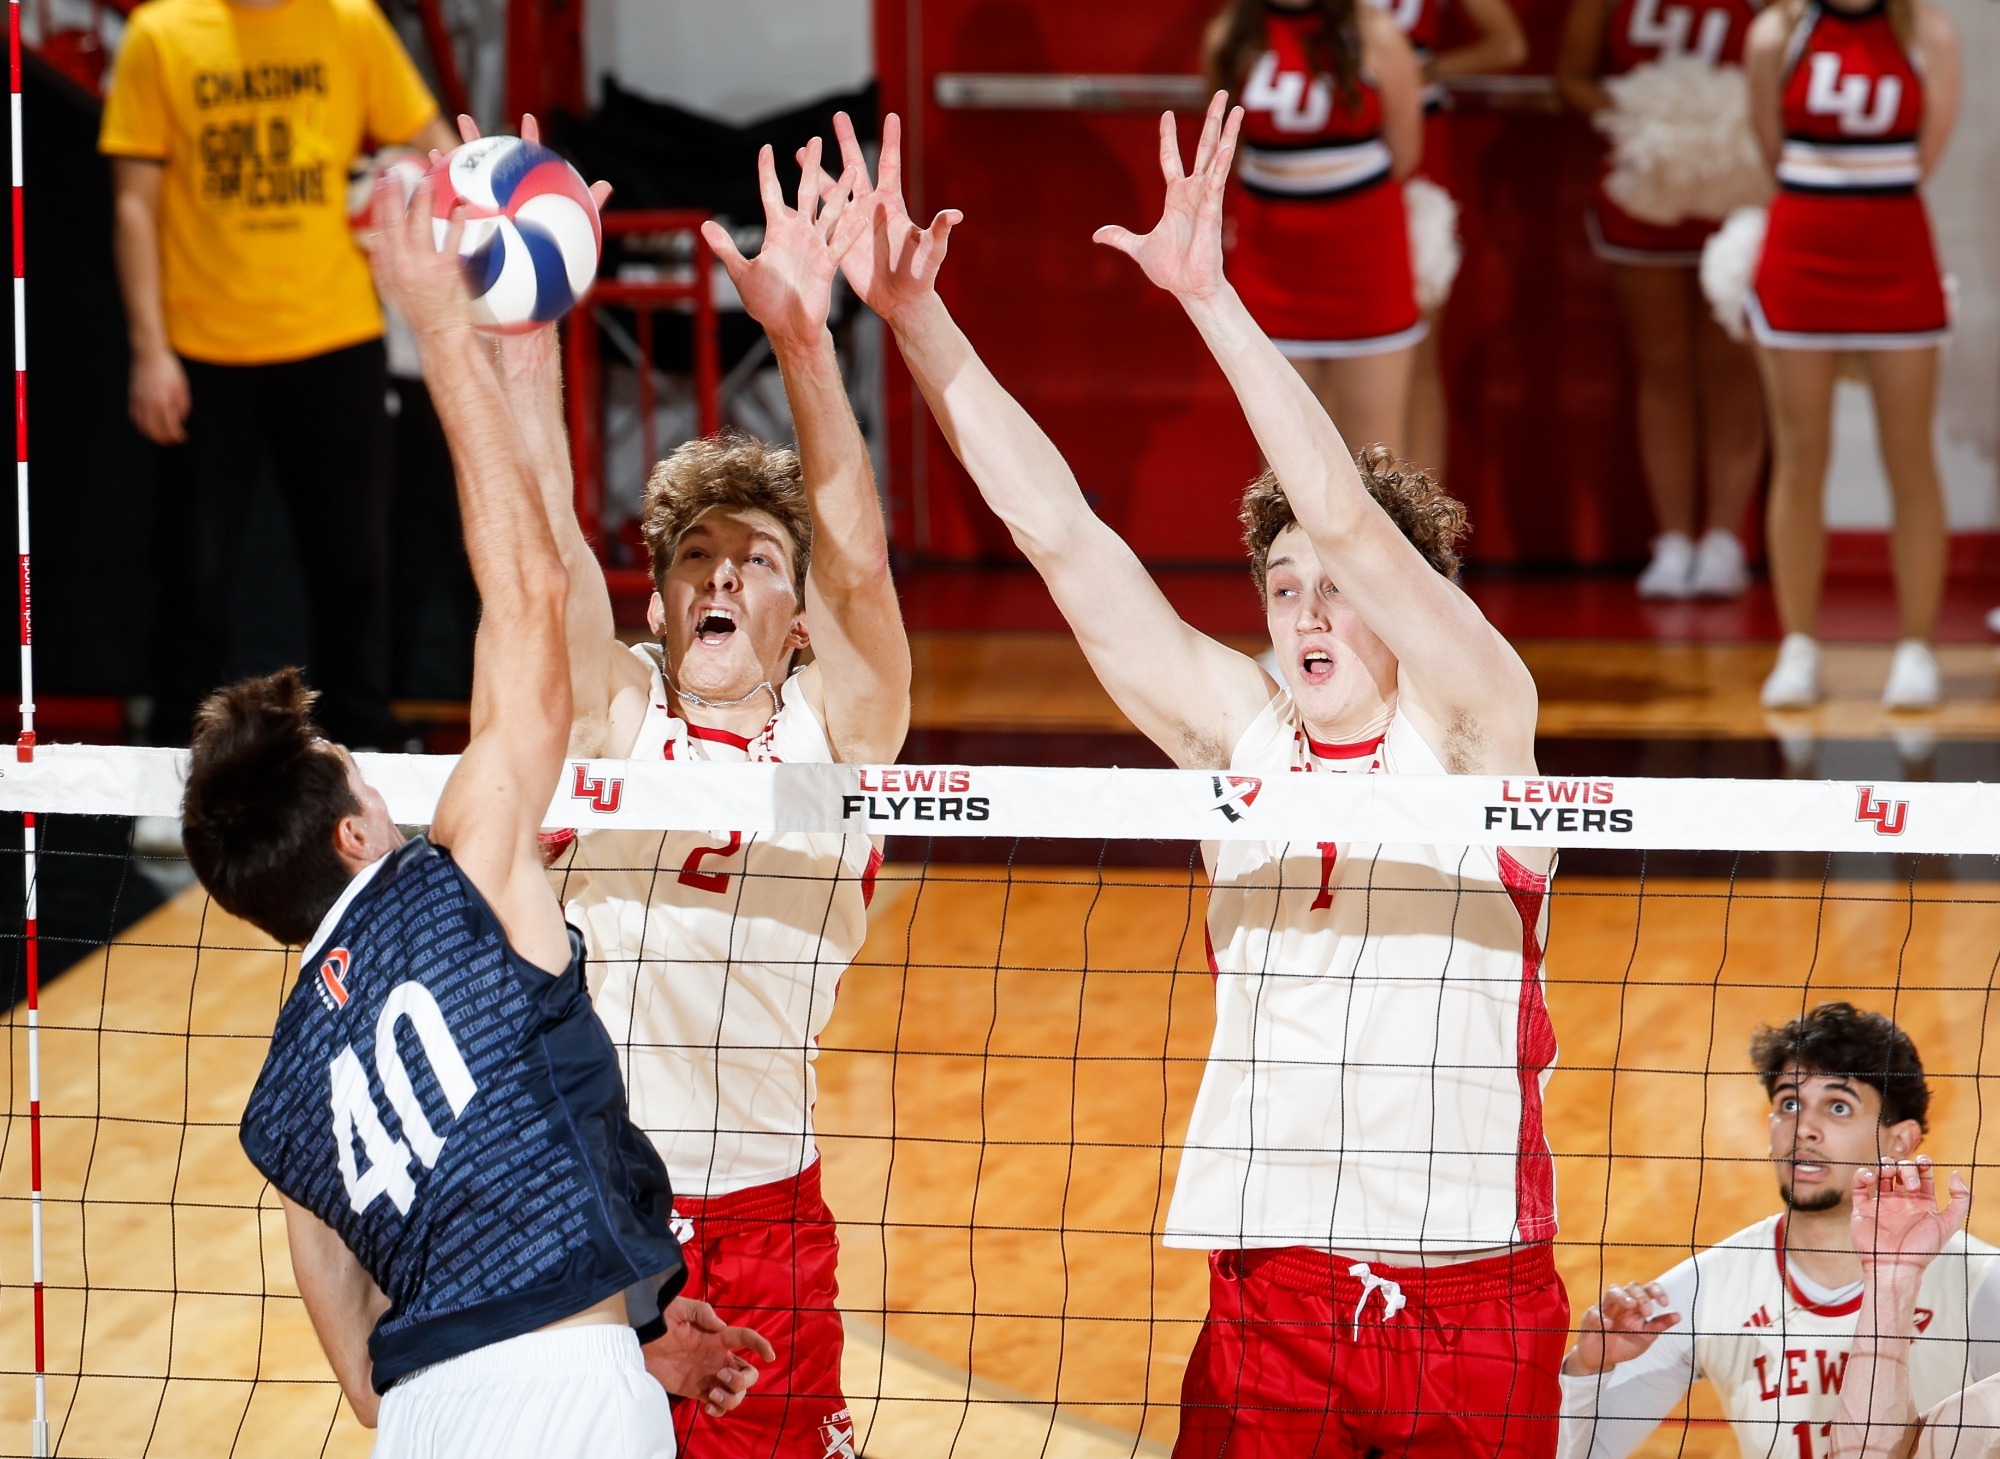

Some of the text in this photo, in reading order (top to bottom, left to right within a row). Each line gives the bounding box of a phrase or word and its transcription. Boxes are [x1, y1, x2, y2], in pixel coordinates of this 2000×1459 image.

[1244, 53, 1332, 132] LU
[1806, 53, 1899, 134] LU
[570, 762, 624, 814] LU
[859, 769, 970, 794] LEWIS
[1502, 780, 1614, 804] LEWIS
[842, 795, 989, 821] FLYERS
[1484, 806, 1633, 833] FLYERS
[1854, 785, 1910, 837] LU
[678, 831, 741, 894] 2
[1310, 842, 1337, 912] 1
[417, 956, 454, 986] ENMARK,
[330, 980, 477, 1217] 40
[519, 1117, 552, 1142] SHARP,
[1754, 1350, 1849, 1401] LEW
